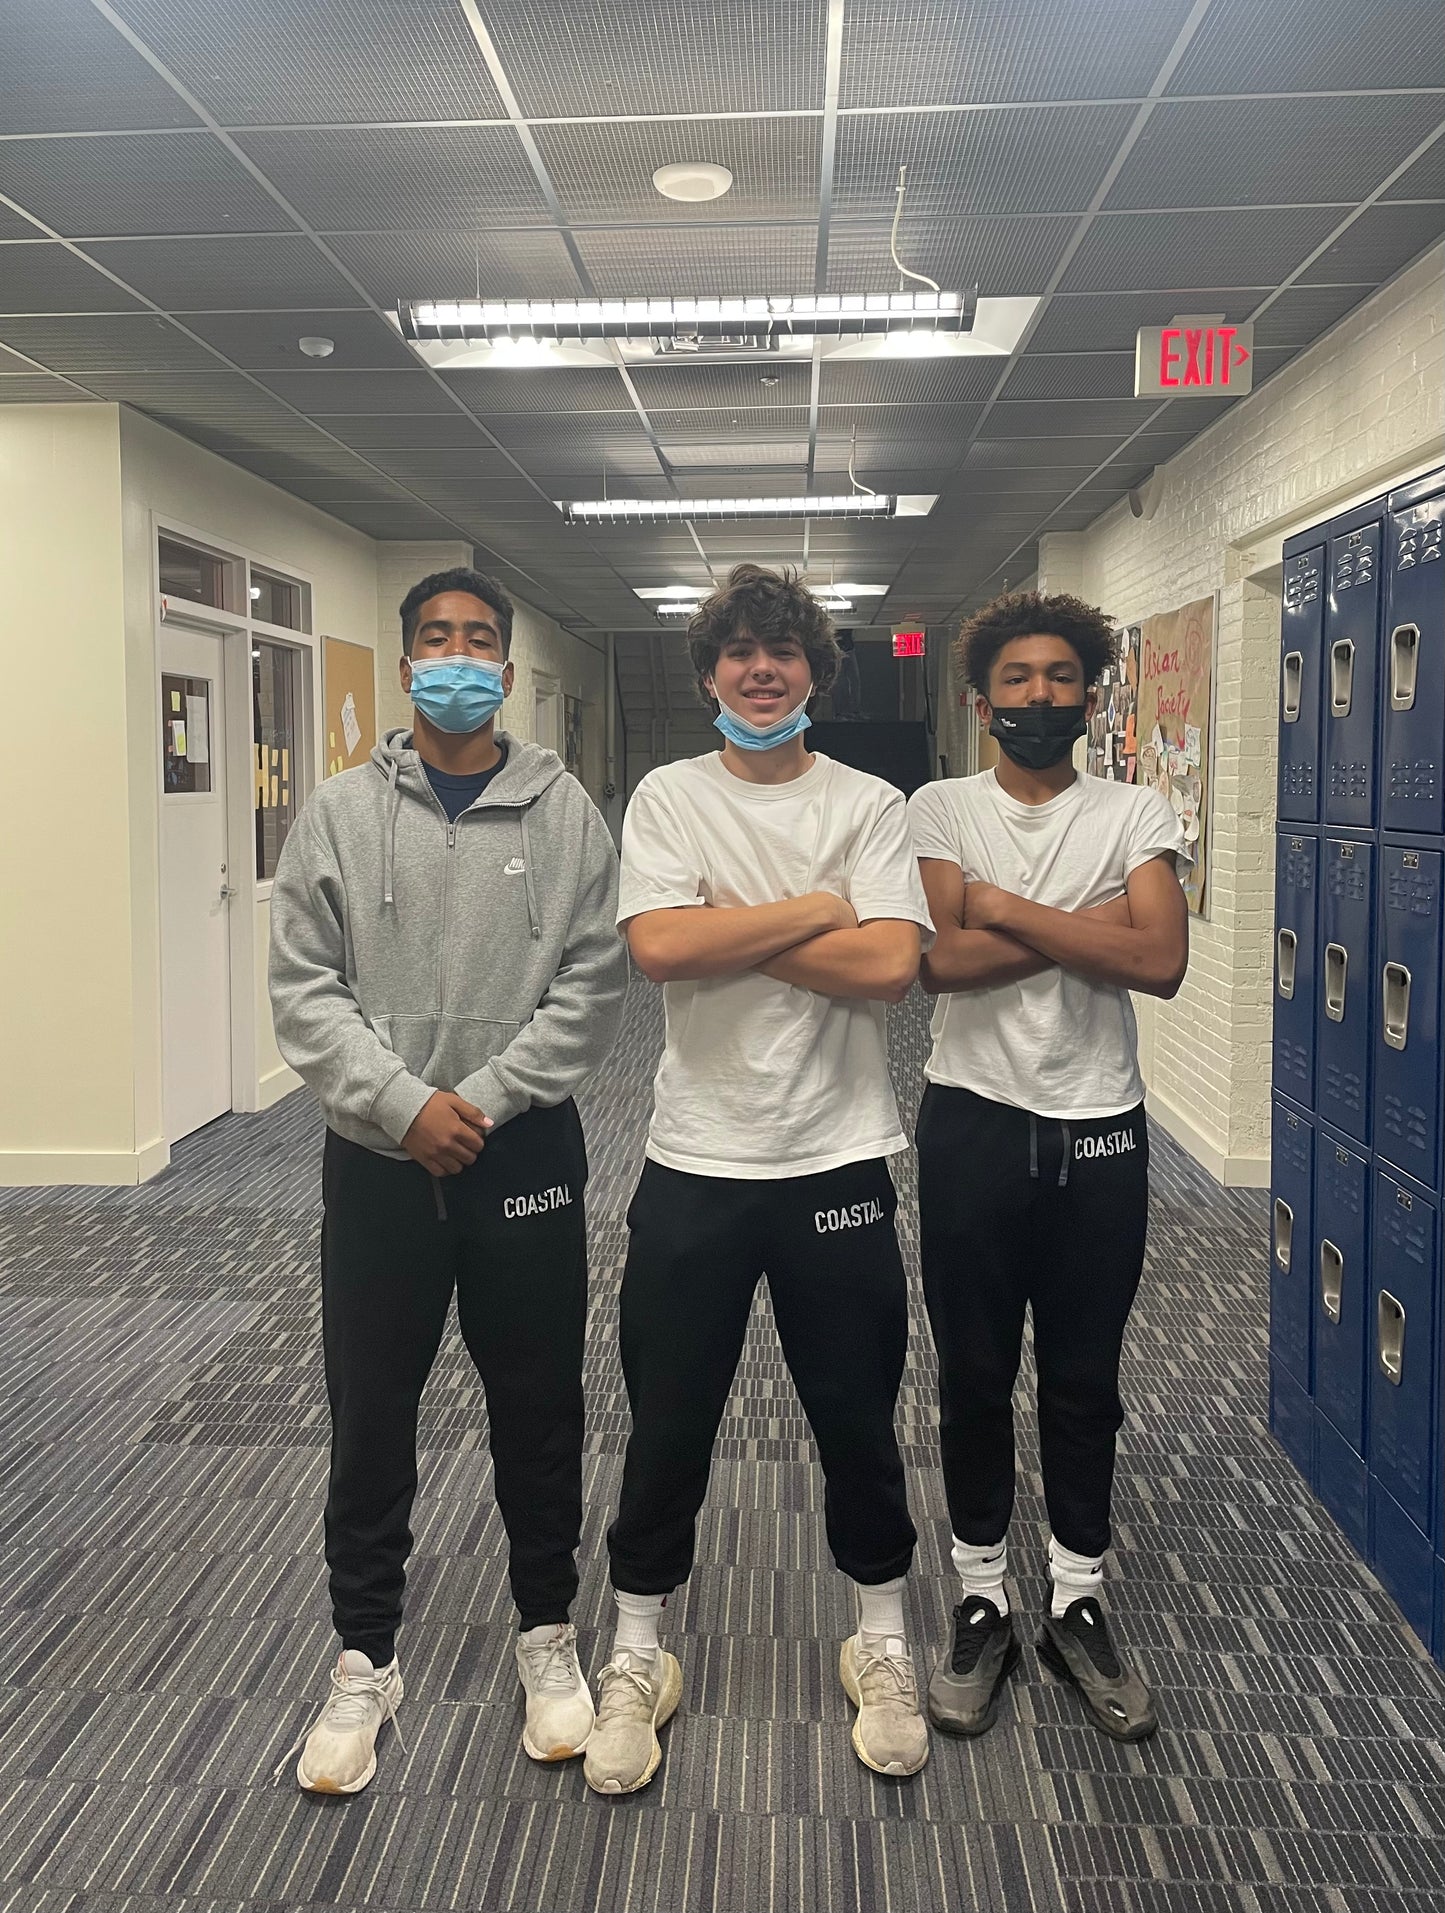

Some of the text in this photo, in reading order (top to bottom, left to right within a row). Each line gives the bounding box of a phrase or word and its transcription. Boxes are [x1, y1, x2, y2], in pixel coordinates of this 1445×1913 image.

[1160, 328, 1237, 387] EXIT
[896, 634, 922, 655] EXIT
[1155, 680, 1191, 722] Society
[509, 857, 526, 869] NIK
[1075, 1127, 1137, 1160] COASTAL
[503, 1183, 573, 1219] COASTAL
[814, 1197, 885, 1233] COASTAL
